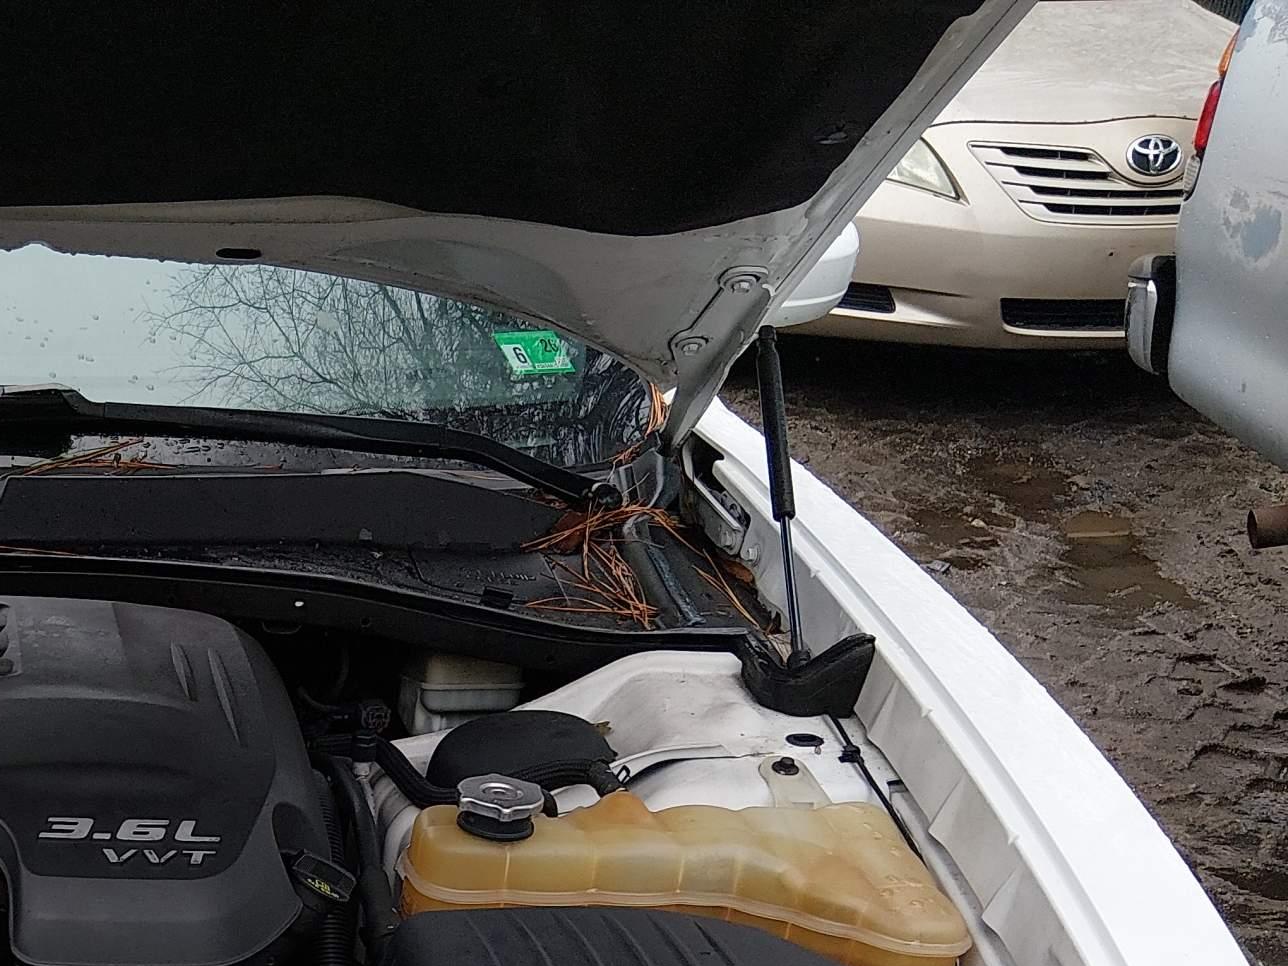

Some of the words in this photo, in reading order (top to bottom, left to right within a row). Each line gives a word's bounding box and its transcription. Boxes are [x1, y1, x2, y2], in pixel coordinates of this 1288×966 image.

[512, 346, 528, 364] 6
[38, 816, 222, 843] 3.6L
[102, 848, 217, 865] VVT
